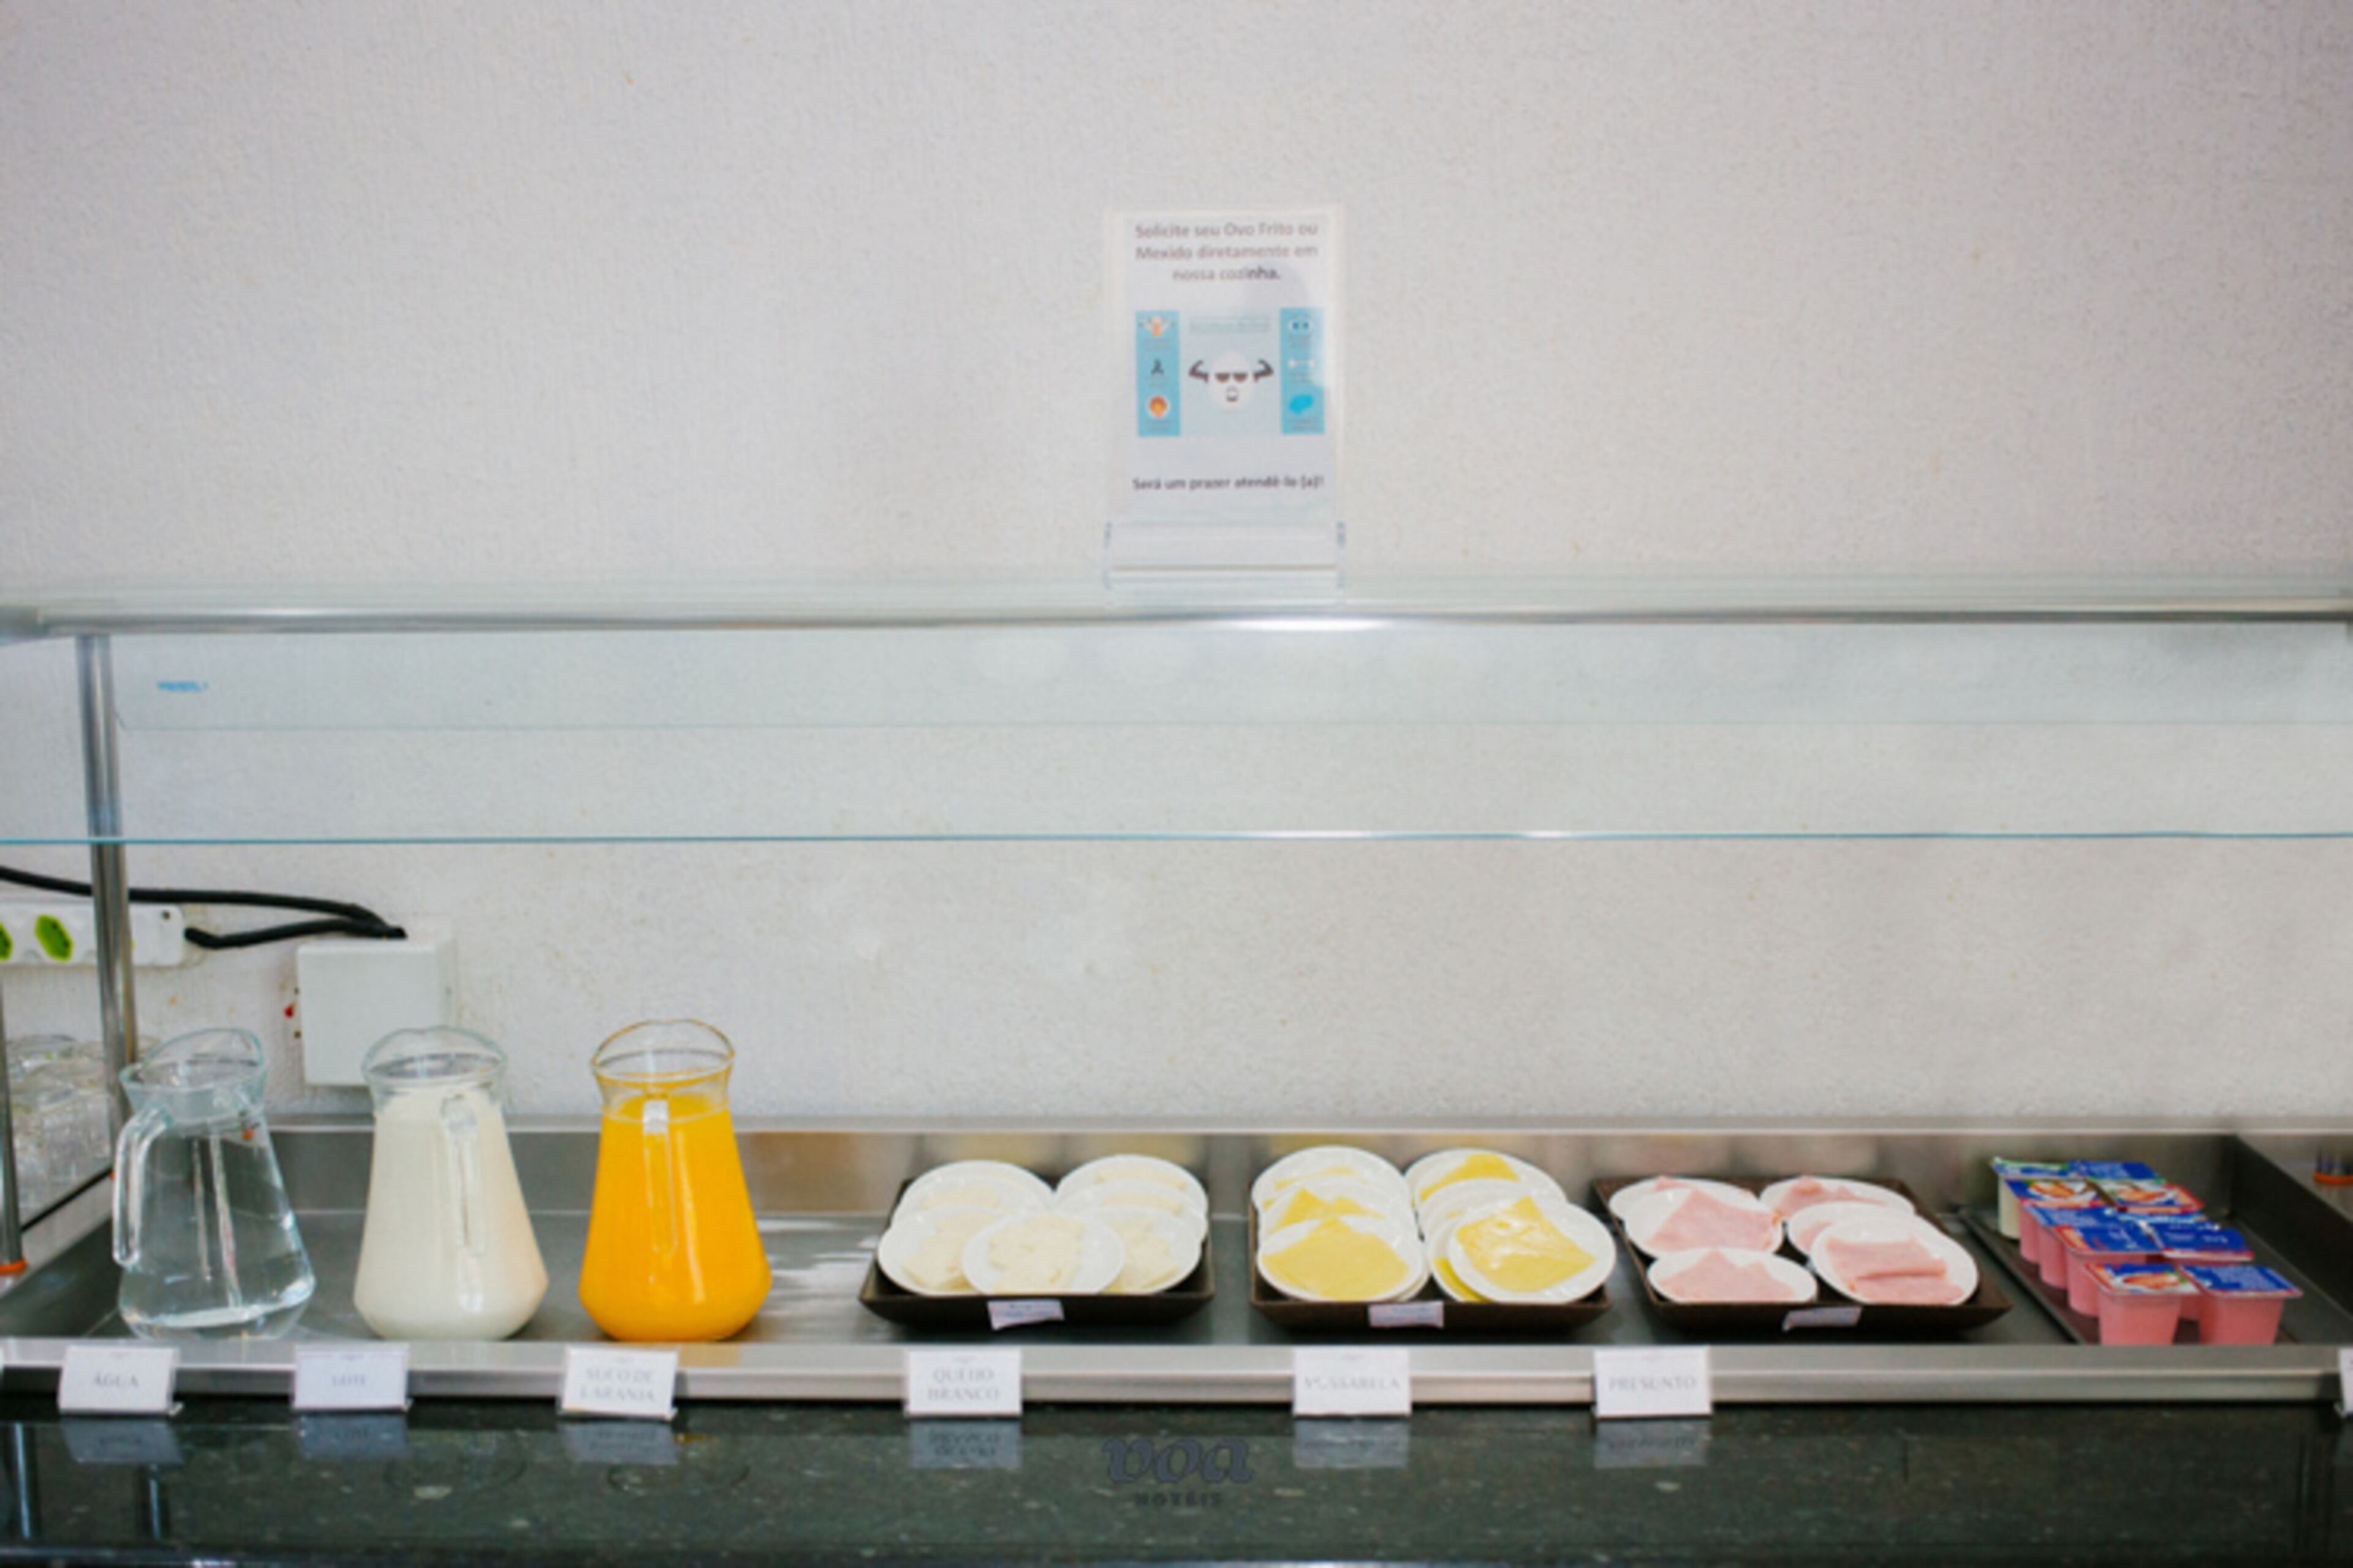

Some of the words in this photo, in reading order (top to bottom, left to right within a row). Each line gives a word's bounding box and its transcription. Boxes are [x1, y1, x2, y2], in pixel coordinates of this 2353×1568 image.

[1135, 222, 1190, 238] Solicite
[1194, 225, 1220, 237] seu
[1224, 222, 1255, 237] Ovo
[1258, 221, 1294, 236] Frito
[1298, 224, 1319, 235] ou
[1135, 246, 1192, 260] Mexido
[1196, 244, 1290, 259] diretamente
[1294, 246, 1319, 257] em
[1172, 269, 1214, 281] nossa
[1220, 265, 1281, 281] cozinha.
[1132, 476, 1162, 490] Será
[1164, 479, 1187, 490] um
[1189, 478, 1231, 492] prazer
[928, 1387, 1001, 1402] BRANCO
